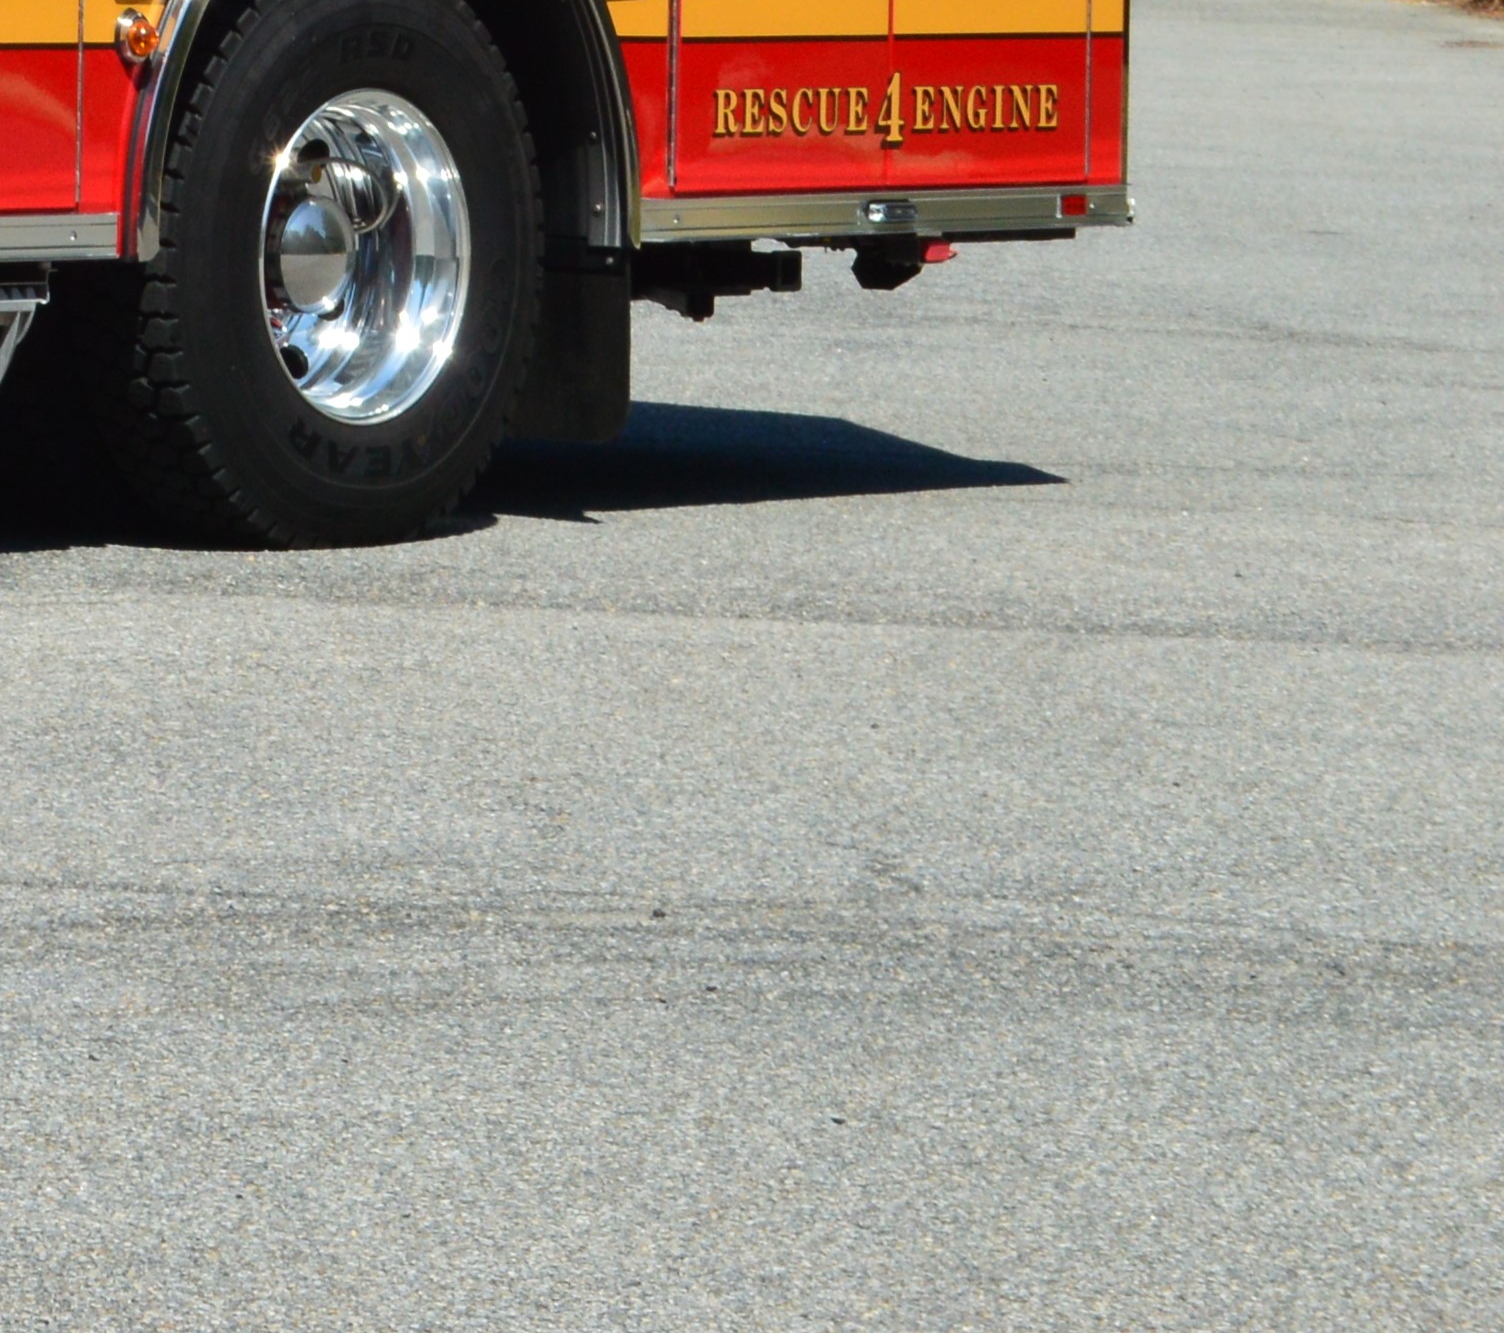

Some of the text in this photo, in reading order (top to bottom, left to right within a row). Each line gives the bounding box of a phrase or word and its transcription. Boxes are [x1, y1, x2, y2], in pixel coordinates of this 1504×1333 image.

[339, 29, 416, 64] RSD
[713, 71, 1060, 148] RESCUE 4 ENGINE
